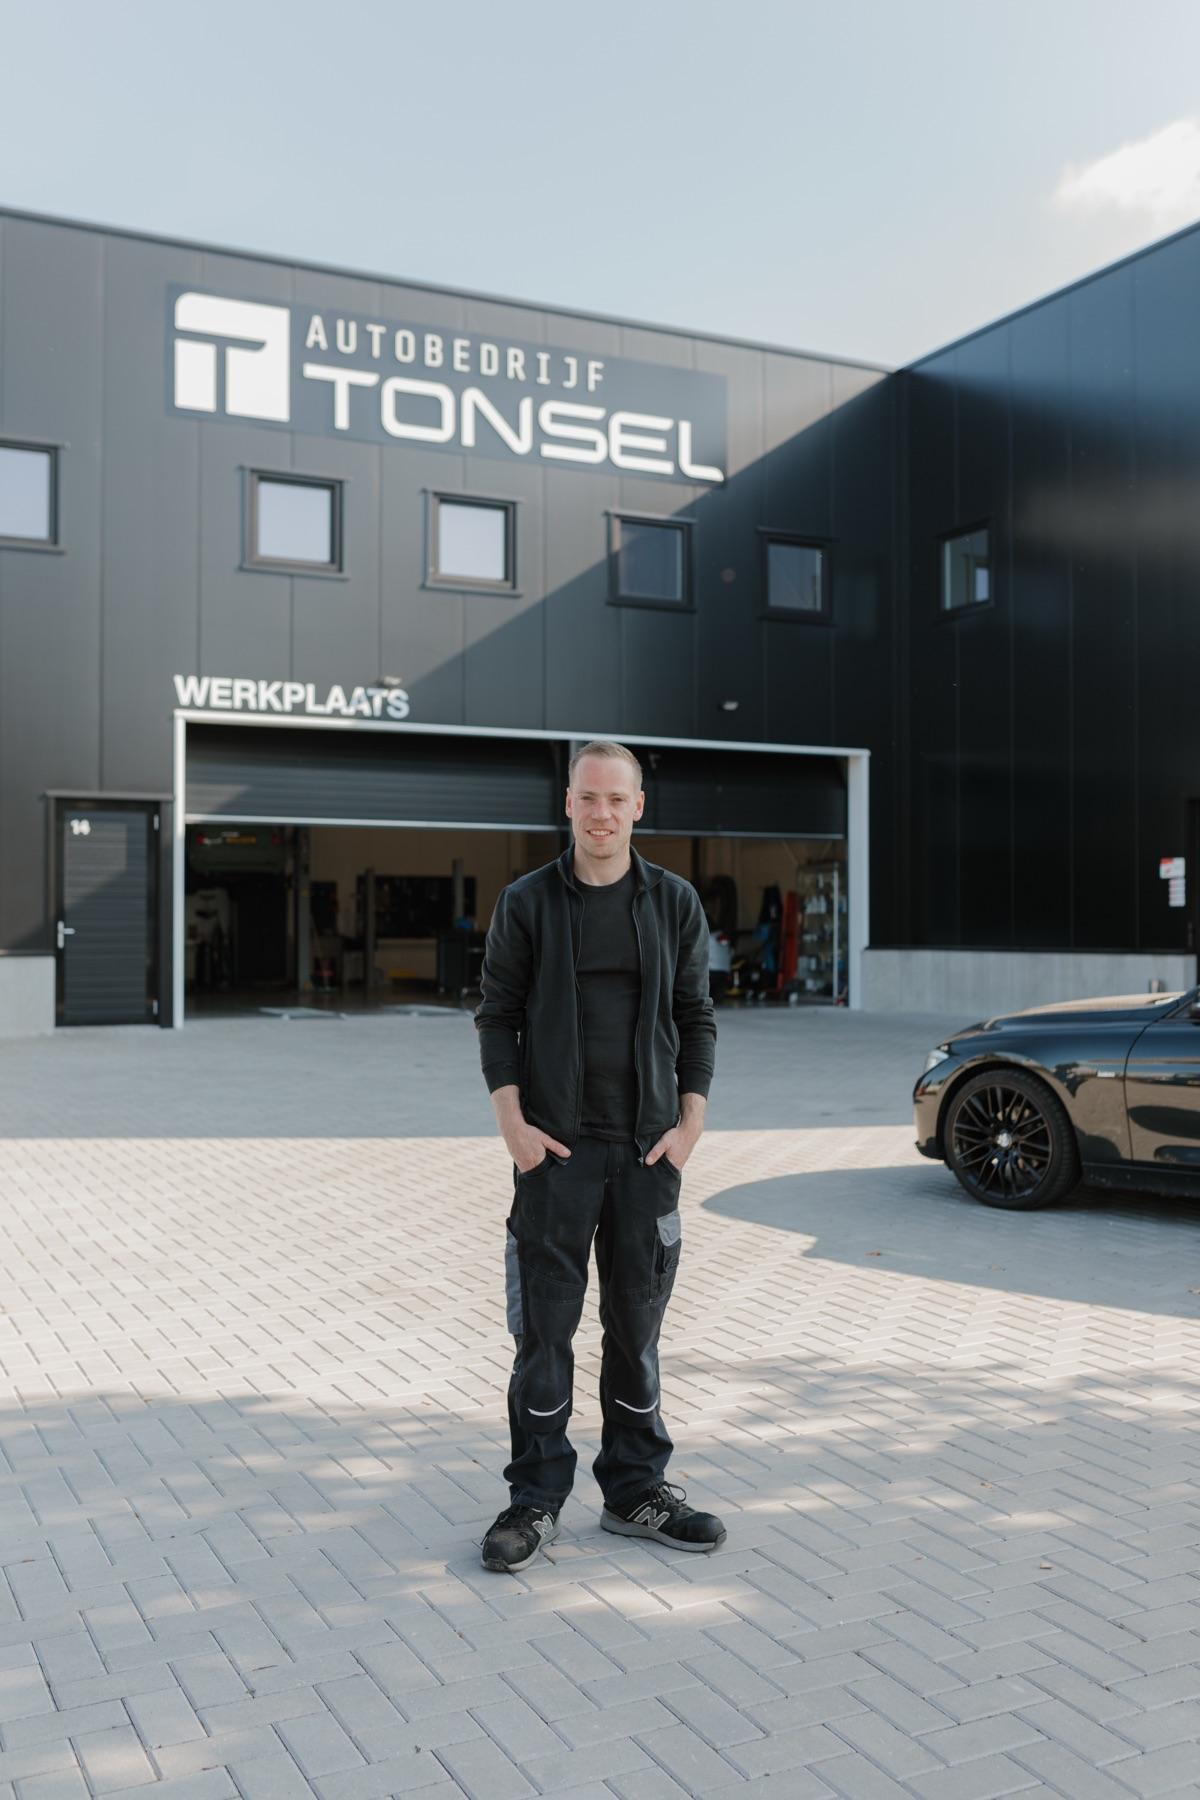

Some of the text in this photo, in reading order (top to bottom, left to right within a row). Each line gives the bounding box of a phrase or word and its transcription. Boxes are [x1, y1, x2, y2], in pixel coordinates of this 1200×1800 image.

[305, 314, 605, 392] AUTOBEDRIJF
[303, 362, 724, 482] TONSEL
[173, 674, 410, 719] WERKPLAATS
